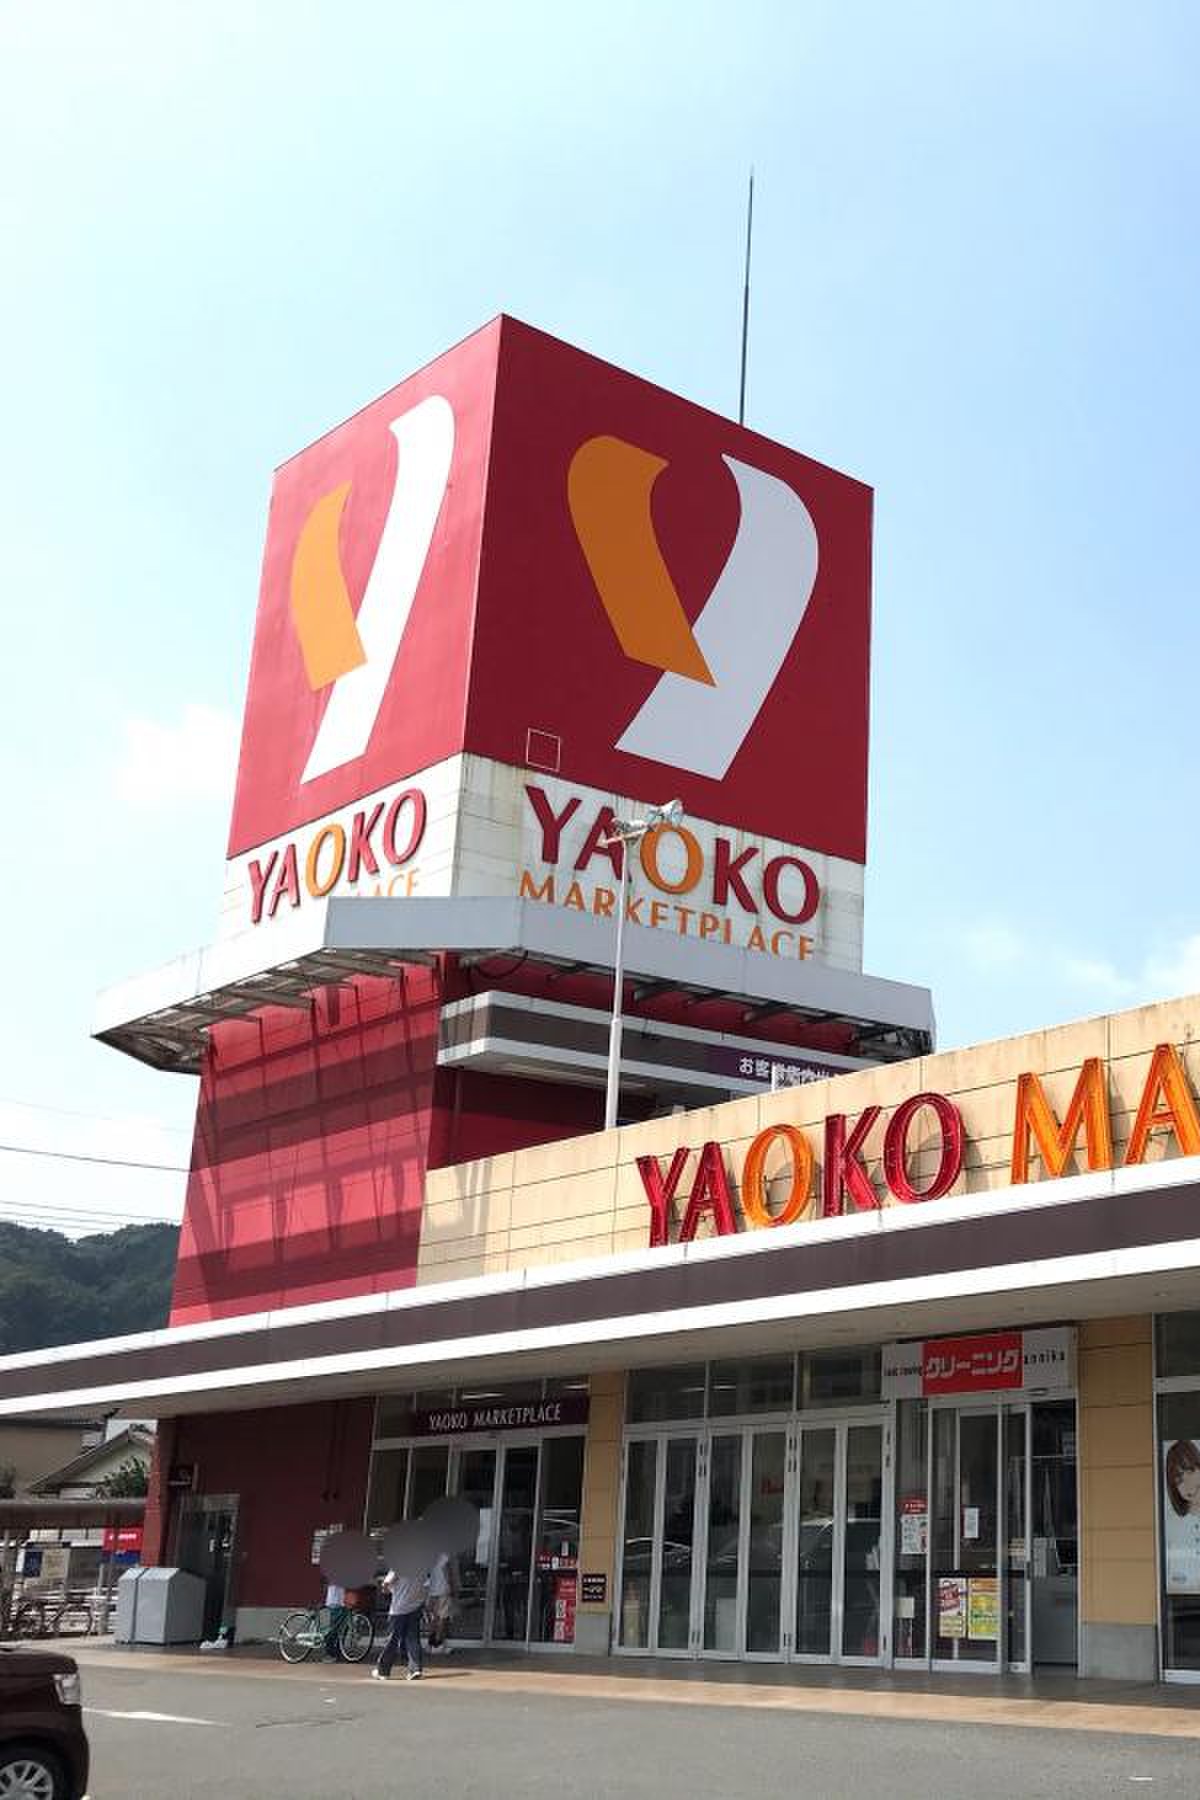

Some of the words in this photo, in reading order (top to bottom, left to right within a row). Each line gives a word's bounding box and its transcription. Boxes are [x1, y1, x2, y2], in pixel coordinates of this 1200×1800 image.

[248, 787, 427, 925] YAOKO
[524, 784, 820, 925] YAOKO
[634, 1090, 968, 1248] YAOKO
[428, 1411, 468, 1432] YAOKO
[472, 1401, 562, 1426] MARKETPLACE
[926, 1349, 1021, 1379] クリーニング
